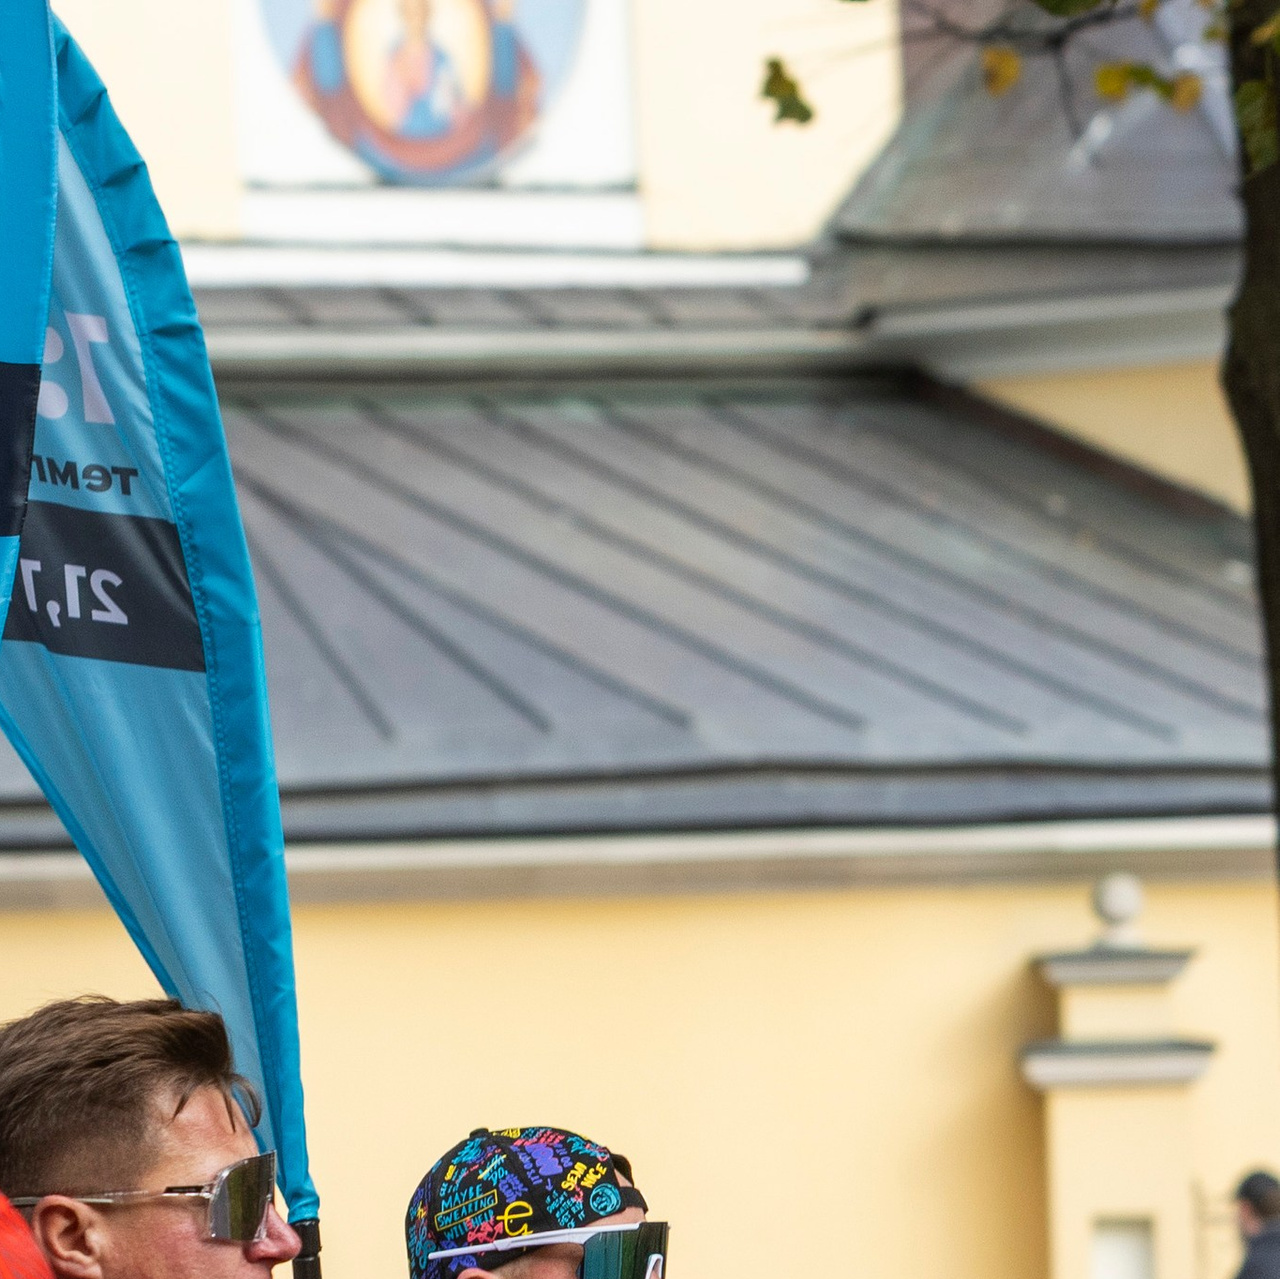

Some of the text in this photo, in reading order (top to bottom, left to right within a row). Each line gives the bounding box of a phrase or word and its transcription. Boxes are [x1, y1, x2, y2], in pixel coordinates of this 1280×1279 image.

[580, 1162, 608, 1189] NICE
[436, 1195, 495, 1228] SWEARING
[441, 1183, 483, 1212] MAYBE
